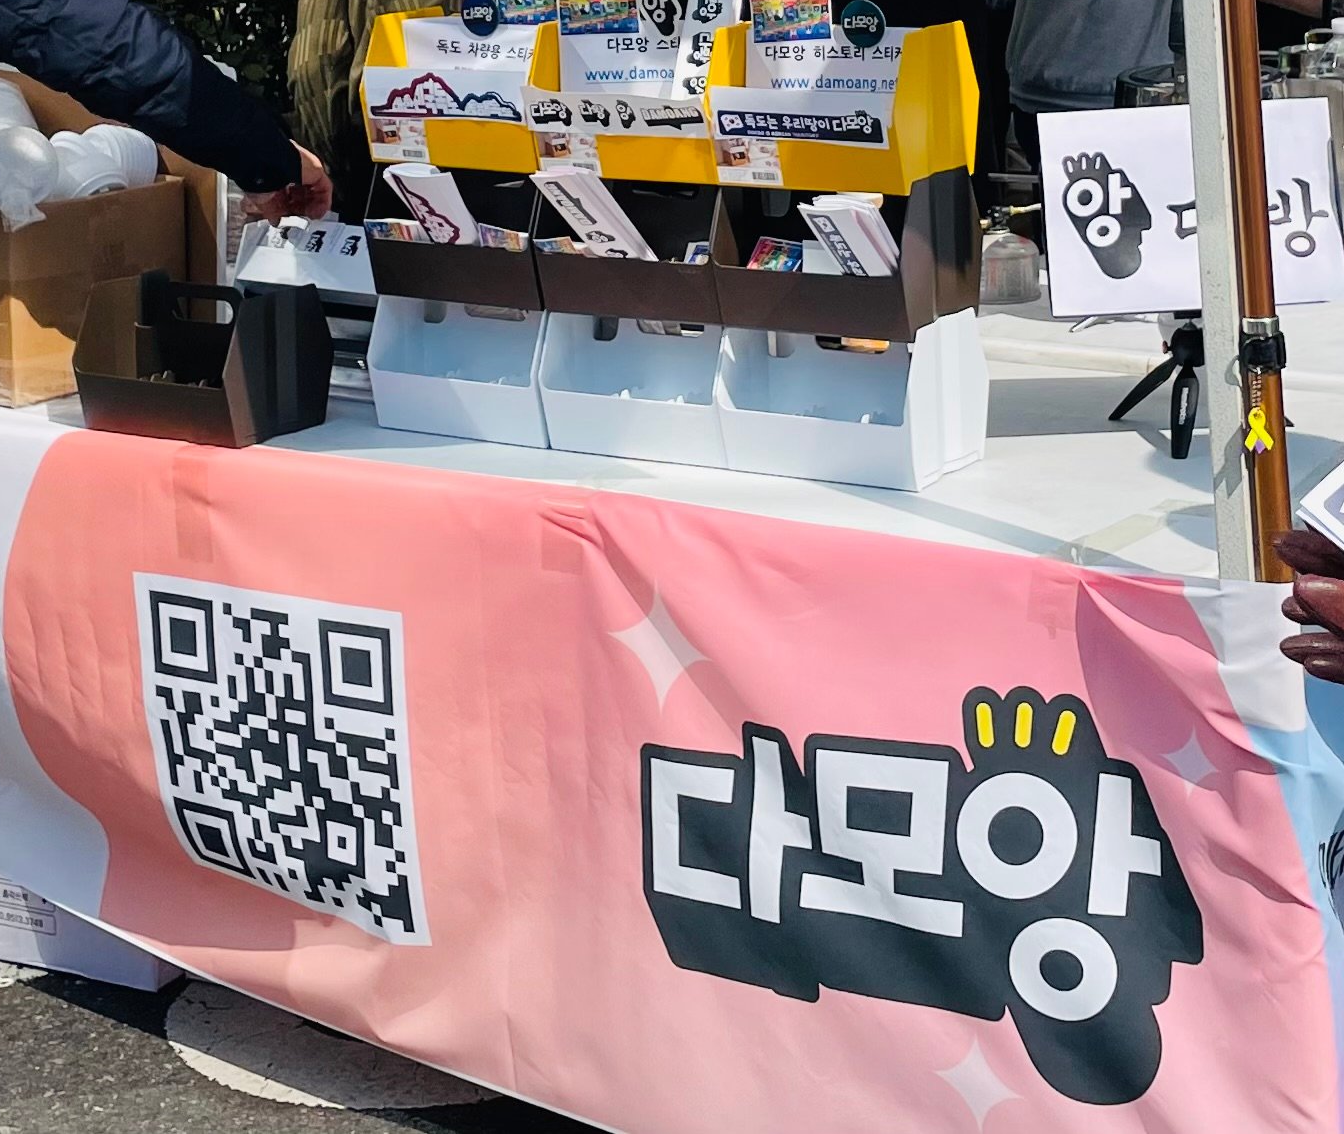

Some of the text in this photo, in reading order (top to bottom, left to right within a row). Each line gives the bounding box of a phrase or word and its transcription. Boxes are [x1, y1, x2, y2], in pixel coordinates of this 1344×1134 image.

[463, 7, 494, 22] 다모앙
[844, 16, 879, 32] 다모앙
[436, 39, 462, 54] 독도
[468, 42, 501, 59] 차량용
[607, 37, 650, 53] 다모앙
[765, 46, 805, 61] 다모앙
[814, 45, 865, 61] 히스토리
[585, 66, 674, 81] www.damoa
[530, 102, 568, 120] 다모앙
[640, 105, 699, 121] DAMOANG
[745, 114, 873, 133] 독도는 우리땅이 다모앙
[1065, 172, 1133, 248] 앙
[650, 735, 1162, 1021] 다모앙
